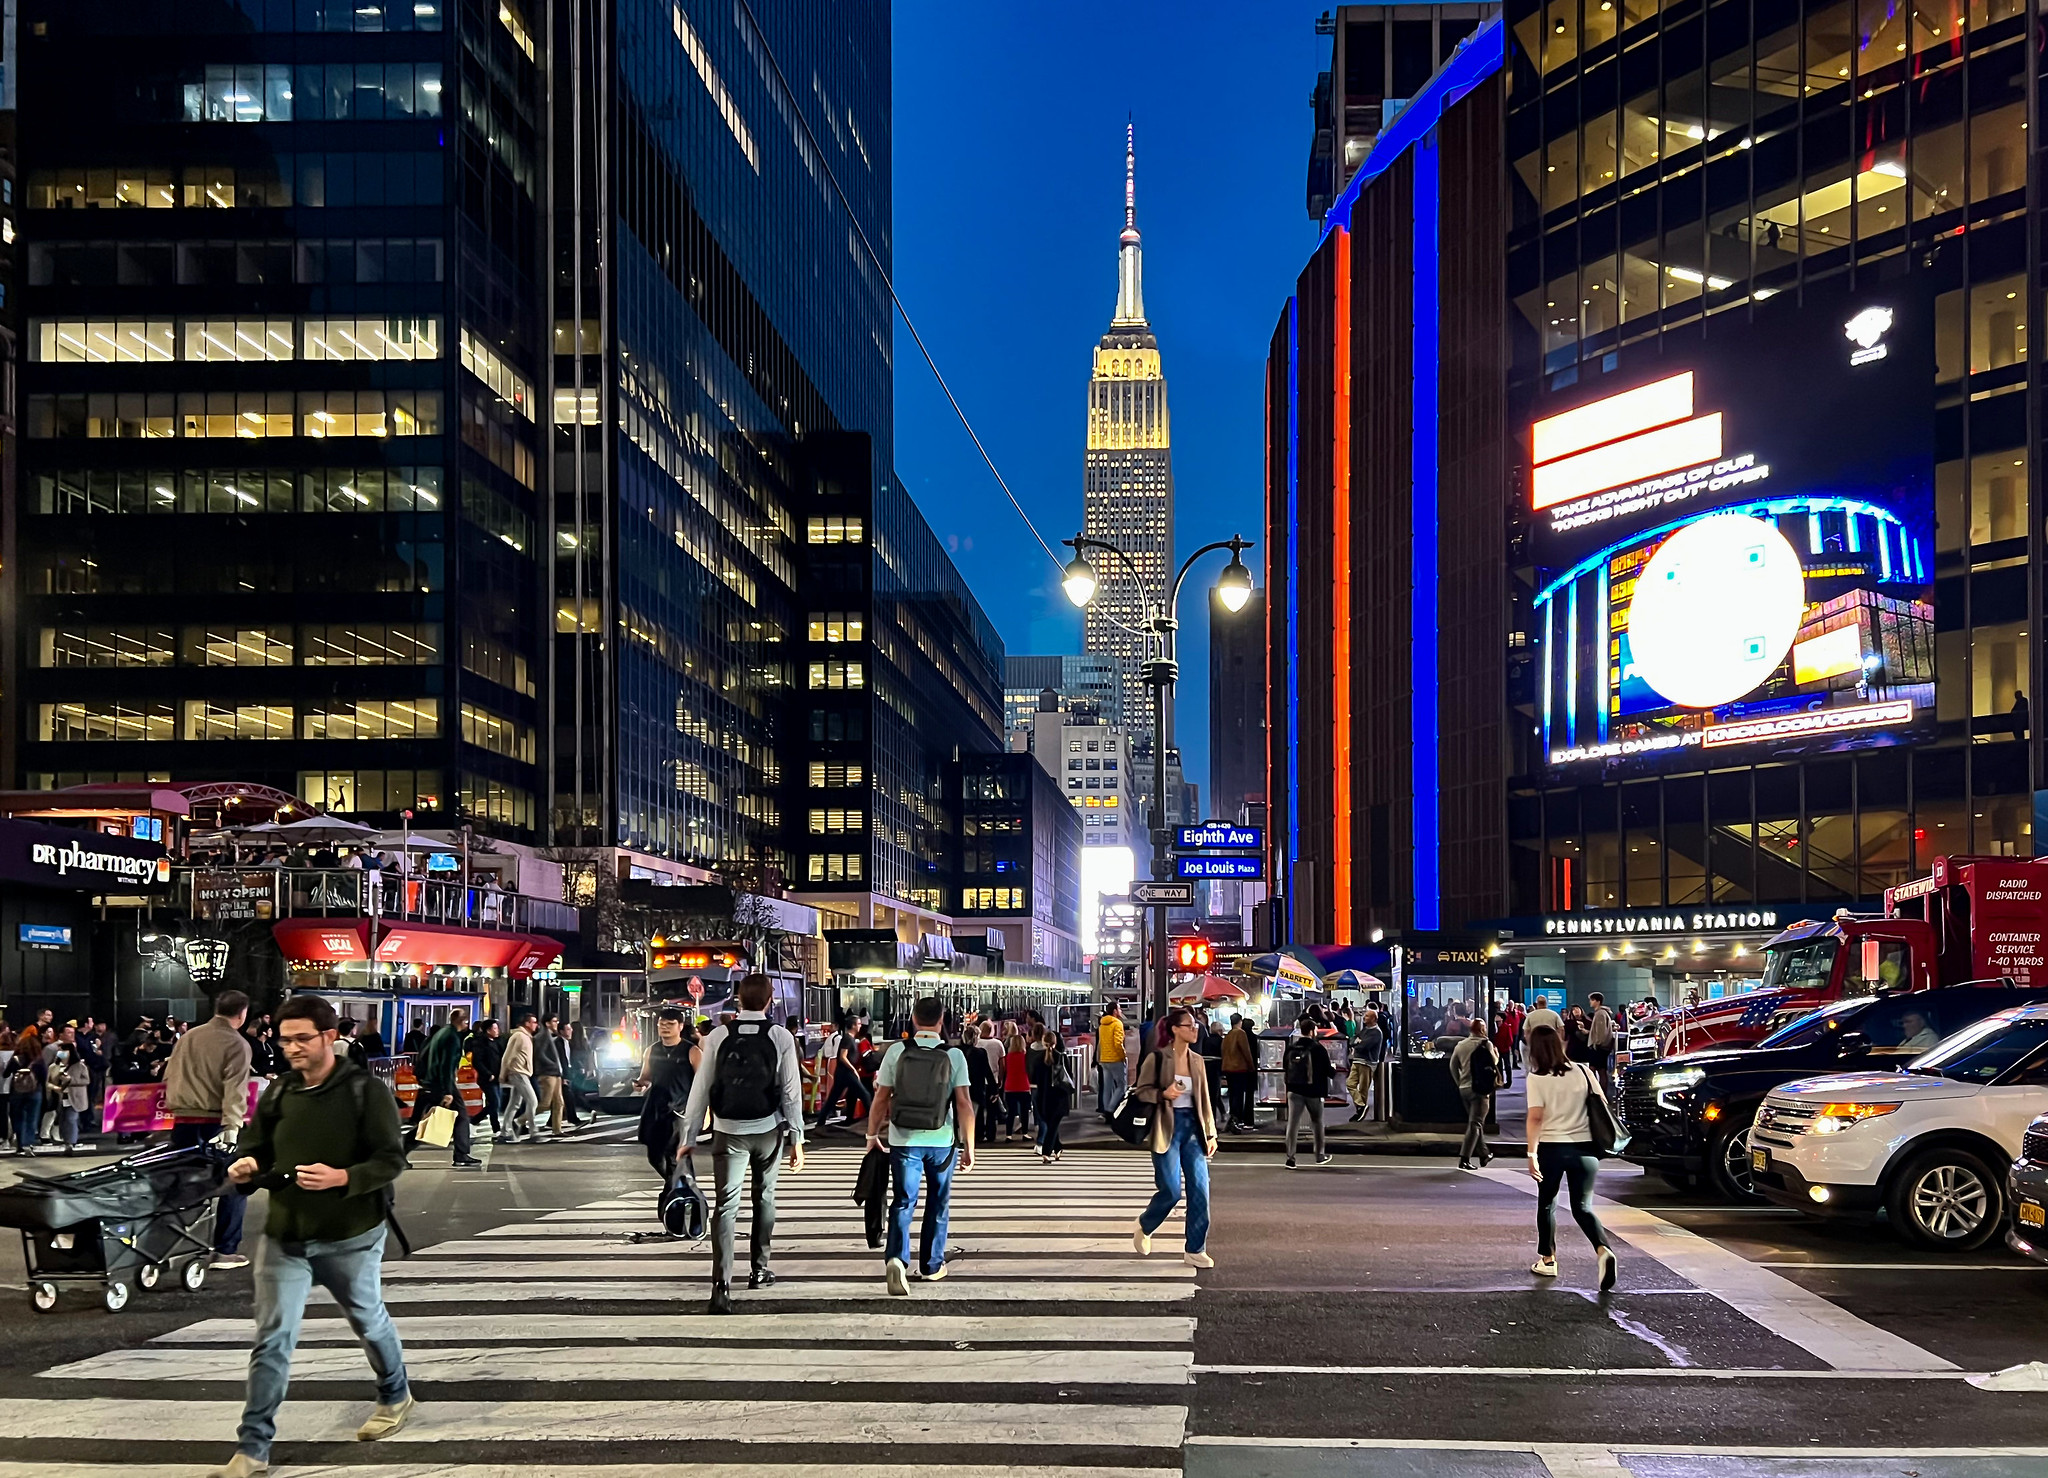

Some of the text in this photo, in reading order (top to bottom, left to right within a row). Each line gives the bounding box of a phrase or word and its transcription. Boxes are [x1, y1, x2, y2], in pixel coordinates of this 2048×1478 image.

[1551, 453, 1755, 519] TAKE ADVANTAGE OF OUR
[1614, 493, 1663, 517] NIGHT
[1708, 465, 1769, 491] OFFER
[1708, 704, 1909, 743] KNICKS.COM/OFFERS
[1552, 732, 1703, 764] EXPLORE GAMES AT
[1183, 830, 1254, 846] Eighth Ave
[33, 840, 157, 885] DR pharmacy
[1184, 861, 1255, 874] Joe Louis Plaza
[1893, 878, 1935, 901] STATEWID
[1999, 879, 2028, 888] RADIO
[1140, 889, 1183, 897] ONE WAY
[1986, 891, 2042, 901] DISPATCHED
[1546, 912, 1777, 935] PENNSYLVANIA STATION
[1989, 932, 2041, 942] CONTAINER
[1451, 951, 1478, 962] TAXI
[1995, 945, 2036, 954] SERVICE
[1988, 956, 2044, 966] 1-40 YARDS
[1279, 971, 1313, 985] SABRETT
